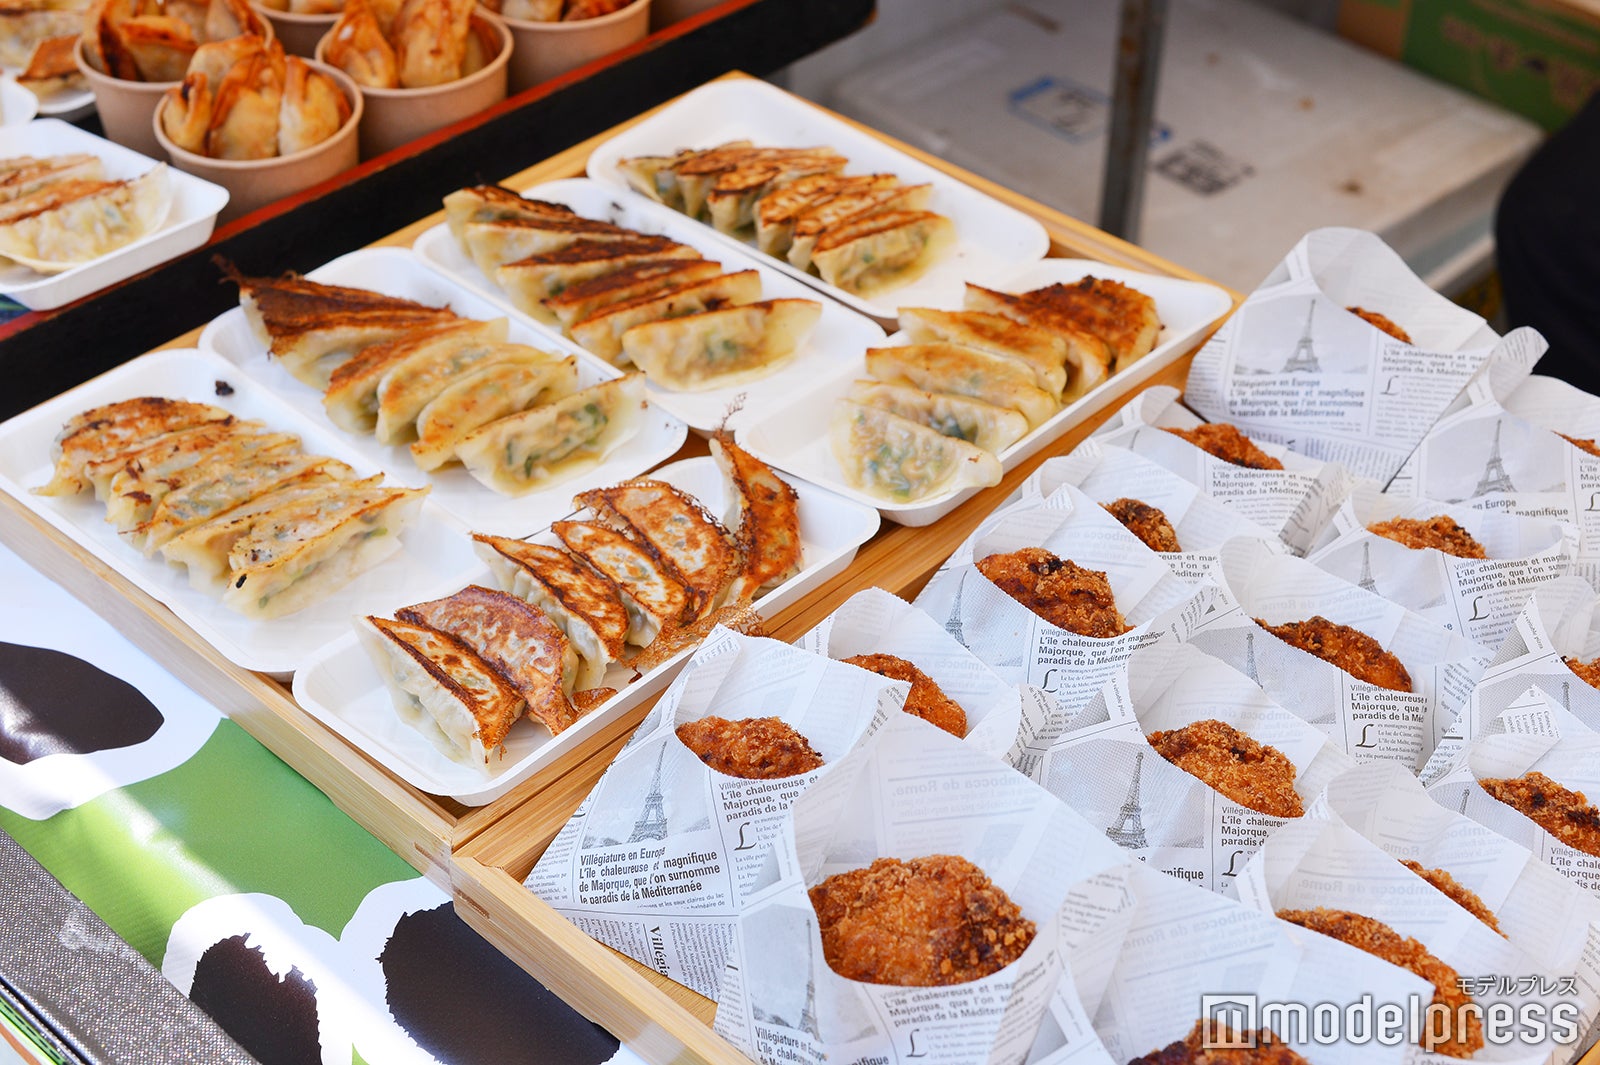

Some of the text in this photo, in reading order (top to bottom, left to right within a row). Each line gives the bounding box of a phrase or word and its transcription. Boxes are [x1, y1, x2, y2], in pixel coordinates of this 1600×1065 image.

[1404, 351, 1453, 359] chaleureuse
[1382, 365, 1412, 373] paradis
[1292, 378, 1320, 389] Europe
[1251, 389, 1299, 397] chaleureuse
[1318, 389, 1365, 398] magnifique
[1238, 408, 1265, 417] paradis
[1291, 408, 1345, 417] Méditerranée
[1213, 480, 1257, 488] Majorque,
[1262, 480, 1278, 488] que
[1213, 488, 1244, 497] paradis
[1486, 500, 1516, 509] Europe
[1516, 508, 1568, 517] magnifique
[1479, 560, 1528, 573] chaleureuse
[1458, 572, 1506, 587] Majorque,
[1509, 570, 1524, 580] que
[1461, 581, 1495, 597] paradis
[1497, 579, 1509, 588] de
[1509, 578, 1517, 586] la
[1062, 638, 1115, 648] chaleureuse
[1118, 637, 1125, 645] et
[1038, 646, 1125, 657] Majorque, que l'on
[1038, 657, 1072, 665] paradis
[1074, 657, 1085, 666] de
[1352, 703, 1419, 713] Majorque, que
[1352, 712, 1386, 721] paradis
[746, 779, 805, 796] chaleureuse
[724, 790, 799, 810] Majorque, que
[726, 802, 788, 822] paradis de la
[1222, 827, 1270, 837] Majorque,
[1221, 838, 1257, 847] paradis
[580, 847, 666, 867] Villégiature en Europe
[601, 863, 648, 877] chaleureuse
[664, 851, 718, 869] magnifique
[579, 882, 588, 892] de
[592, 878, 632, 894] Majorque,
[634, 876, 647, 886] que
[669, 865, 720, 882] surnomme
[590, 891, 618, 905] paradis
[621, 890, 630, 901] de
[632, 889, 640, 900] la
[641, 881, 702, 898] Méditerranée
[912, 987, 974, 1002] chaleureuse
[979, 985, 989, 993] et
[889, 1002, 944, 1017] Majorque,
[949, 999, 968, 1009] que
[894, 1011, 958, 1028] paradis de la
[755, 1026, 799, 1048] Villégiature
